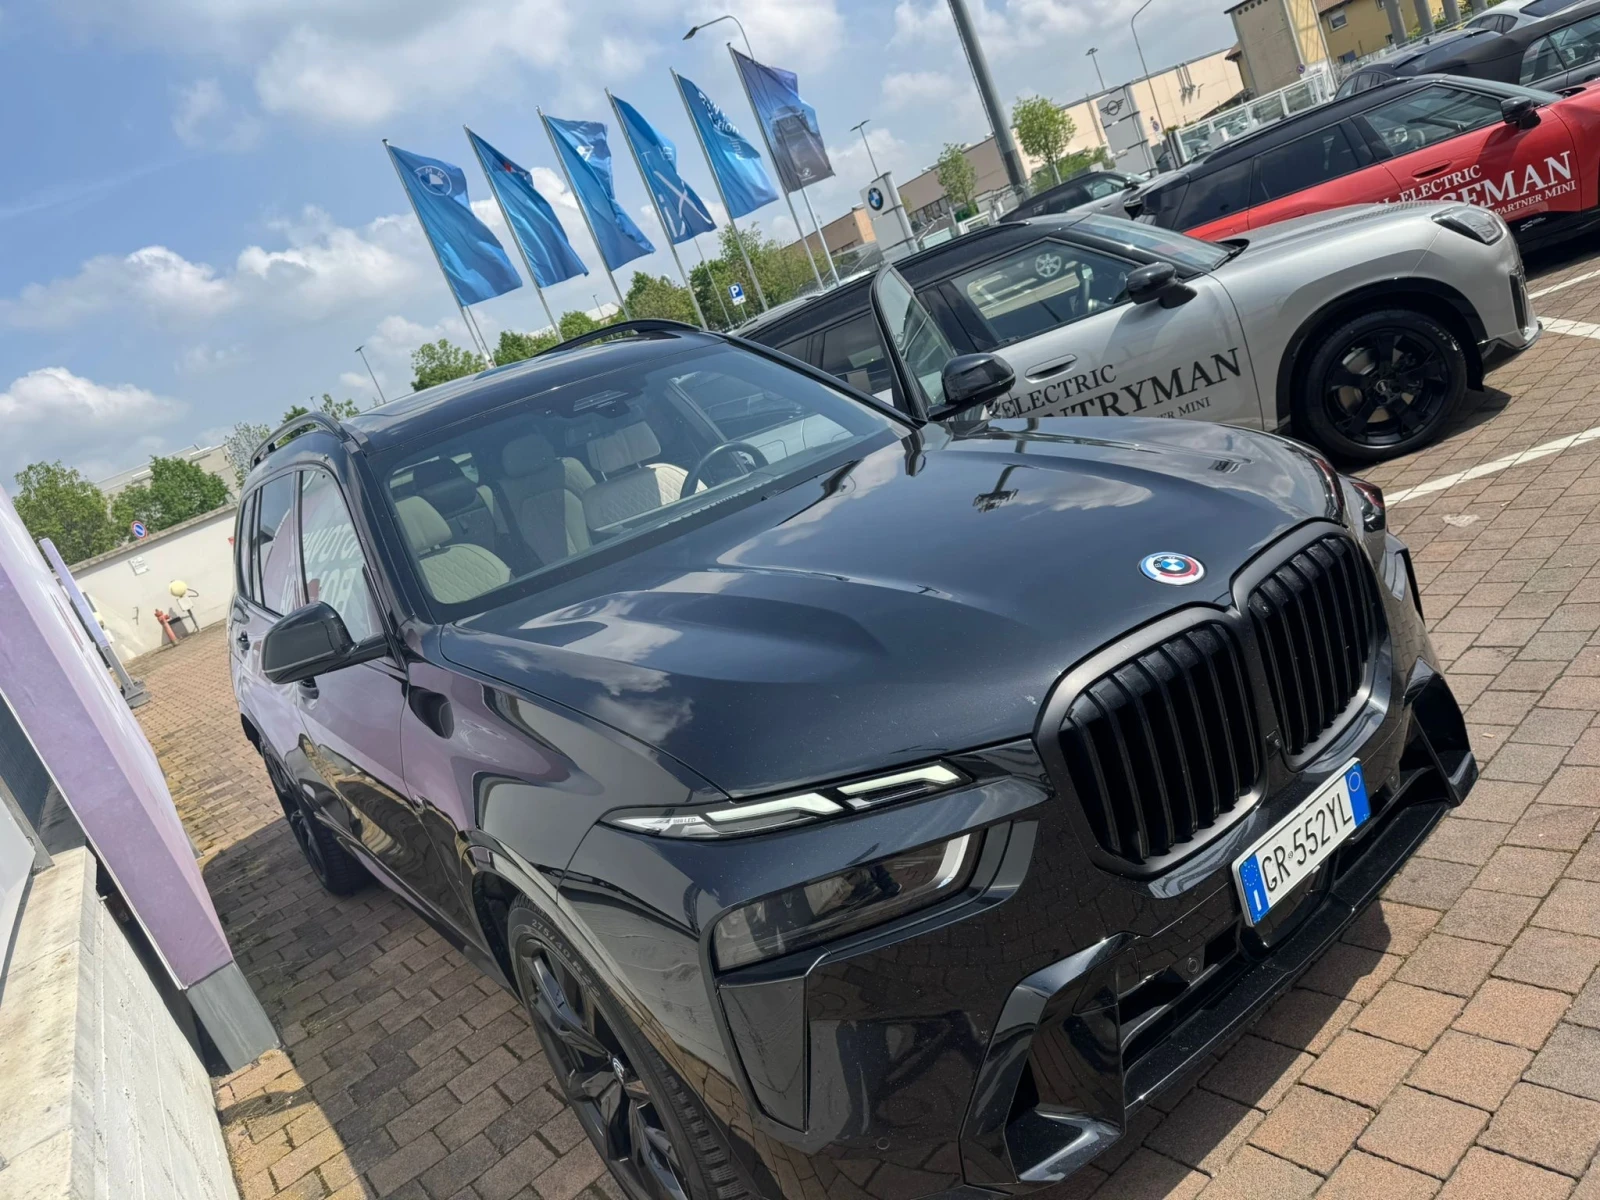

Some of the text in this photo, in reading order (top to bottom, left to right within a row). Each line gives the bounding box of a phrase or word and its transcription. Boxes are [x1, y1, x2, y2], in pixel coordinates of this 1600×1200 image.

[1544, 180, 1577, 200] MINI
[730, 285, 740, 297] P
[1177, 396, 1211, 417] MINI
